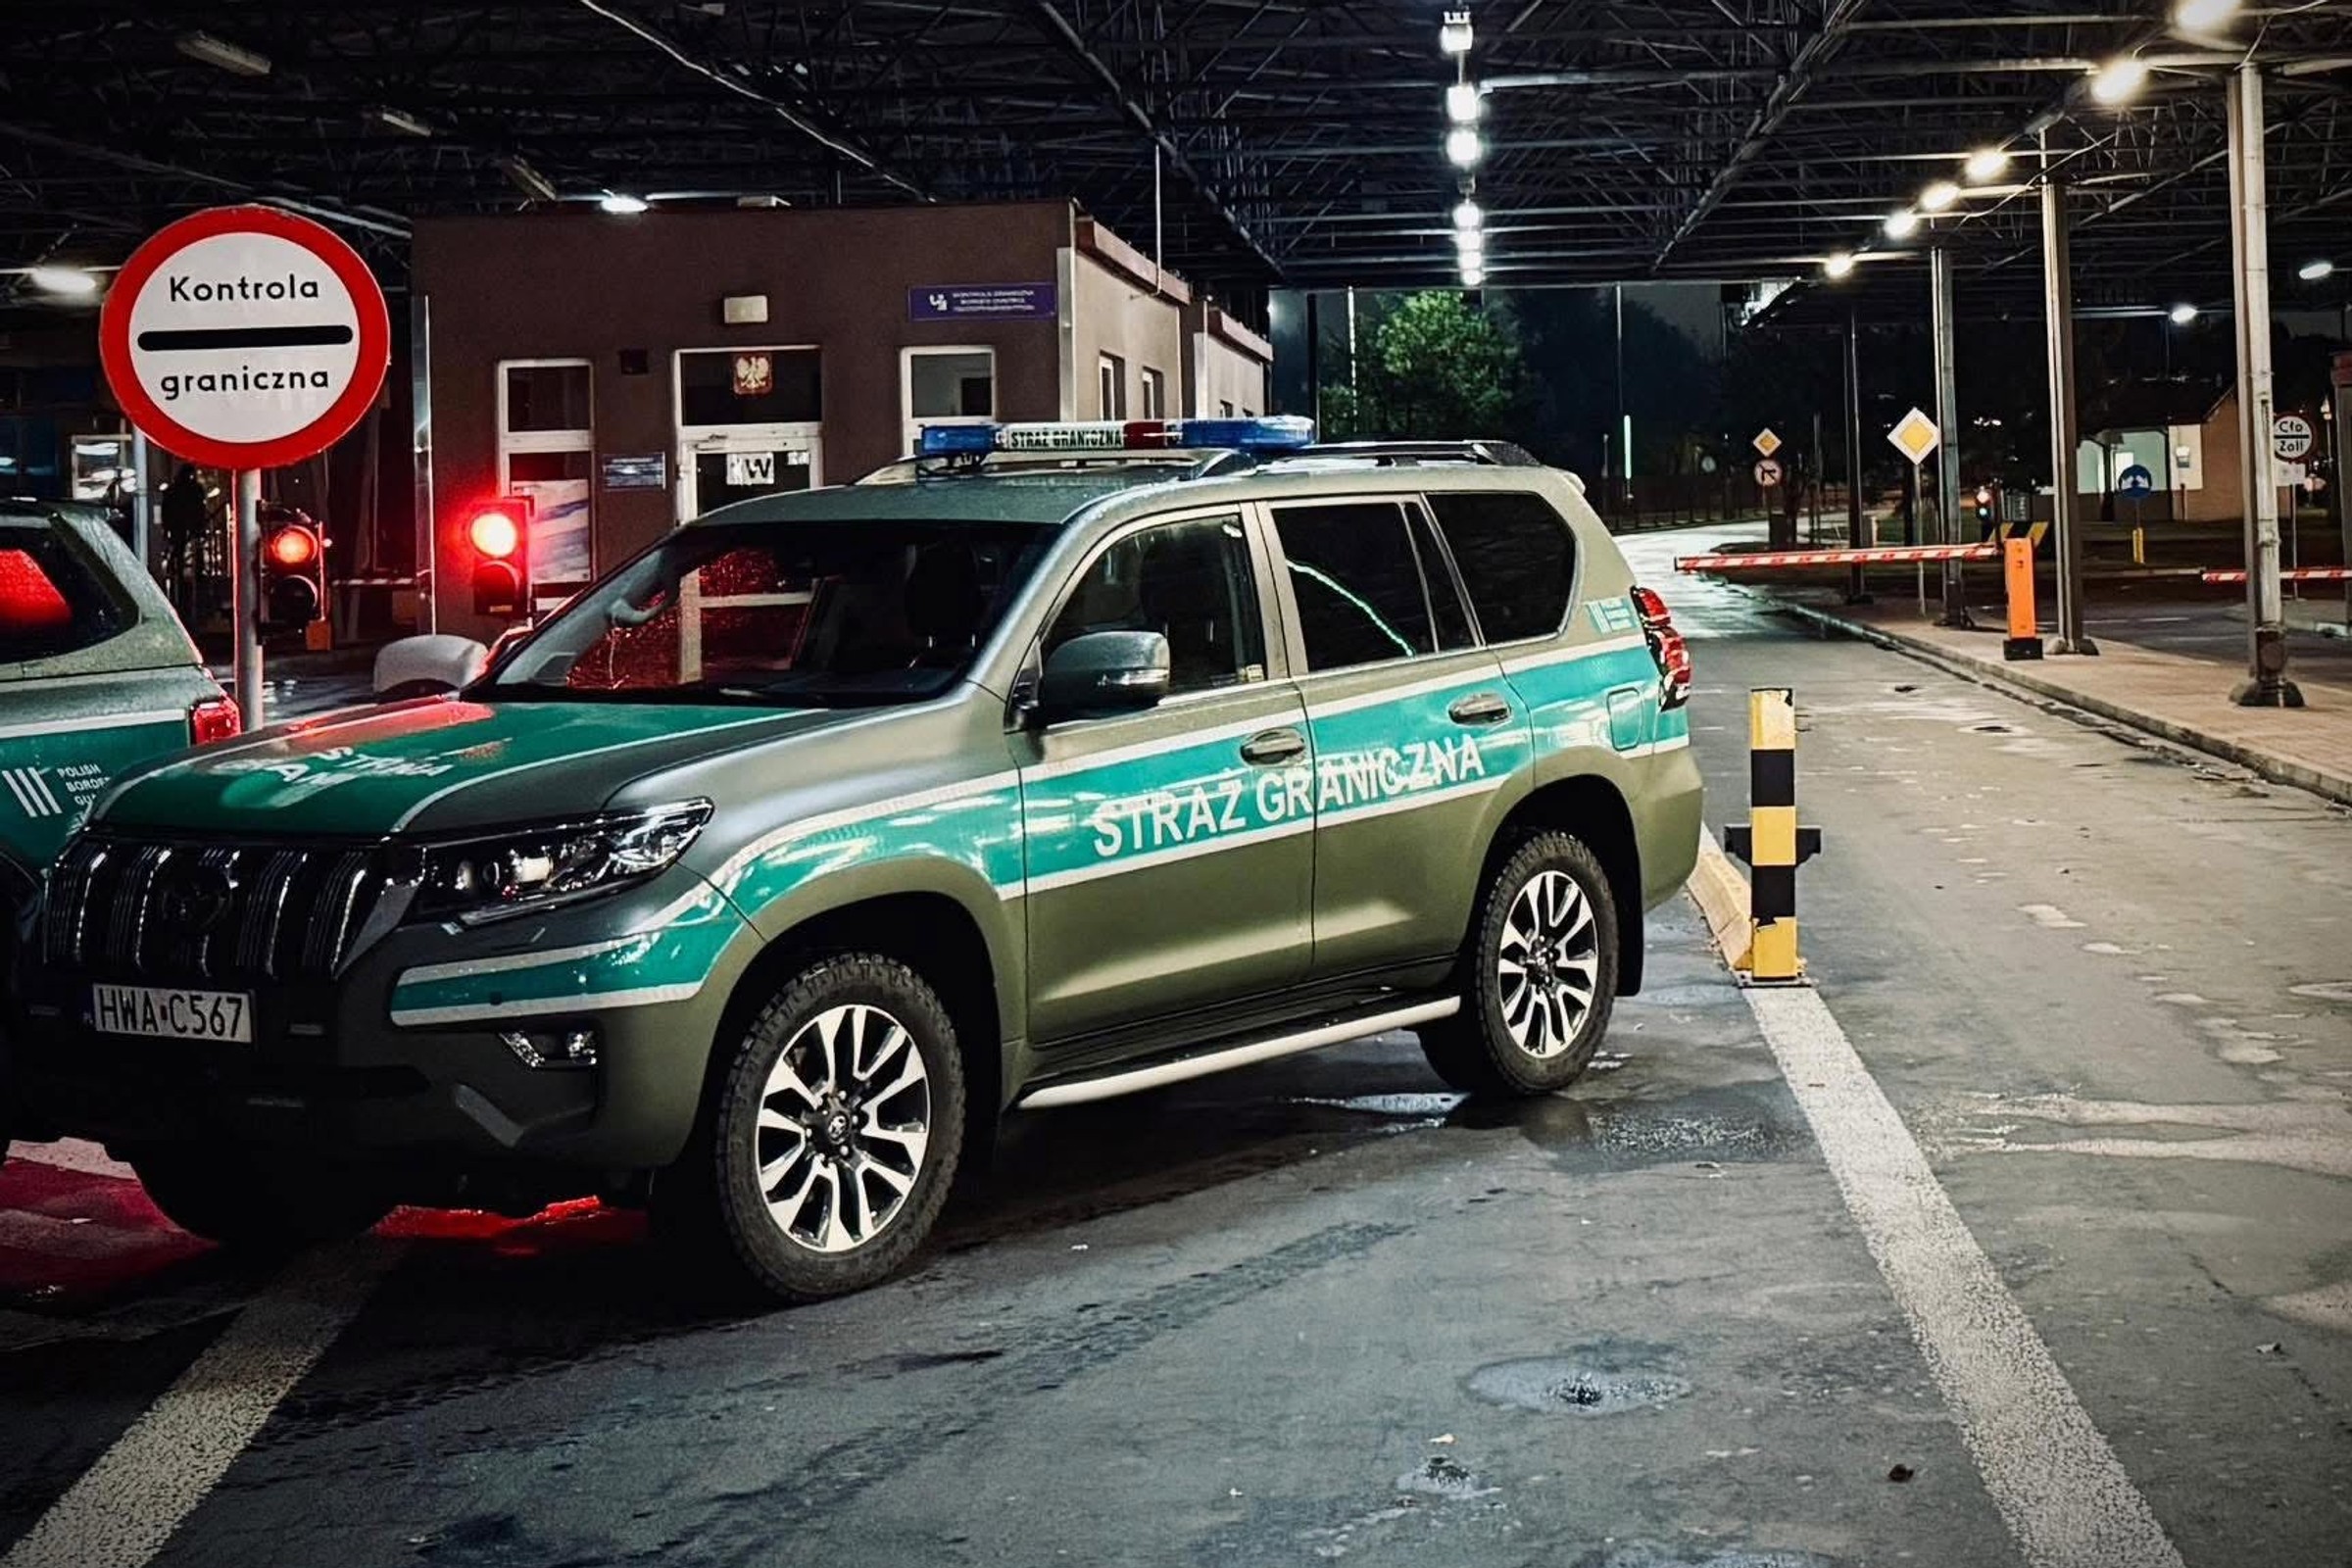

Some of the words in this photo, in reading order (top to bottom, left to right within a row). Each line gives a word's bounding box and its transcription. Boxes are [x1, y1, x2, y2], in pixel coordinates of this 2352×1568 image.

[170, 273, 318, 302] Kontrola
[161, 365, 328, 400] graniczna
[1010, 427, 1050, 448] STRAŻ
[1053, 429, 1122, 448] GRANICZNA
[2279, 439, 2303, 452] Zoll
[57, 763, 102, 778] POLISH
[1093, 767, 1247, 858] STRAŻ
[1255, 734, 1487, 823] GRANICZNA
[99, 988, 160, 1033] HWA
[169, 994, 243, 1038] C567
